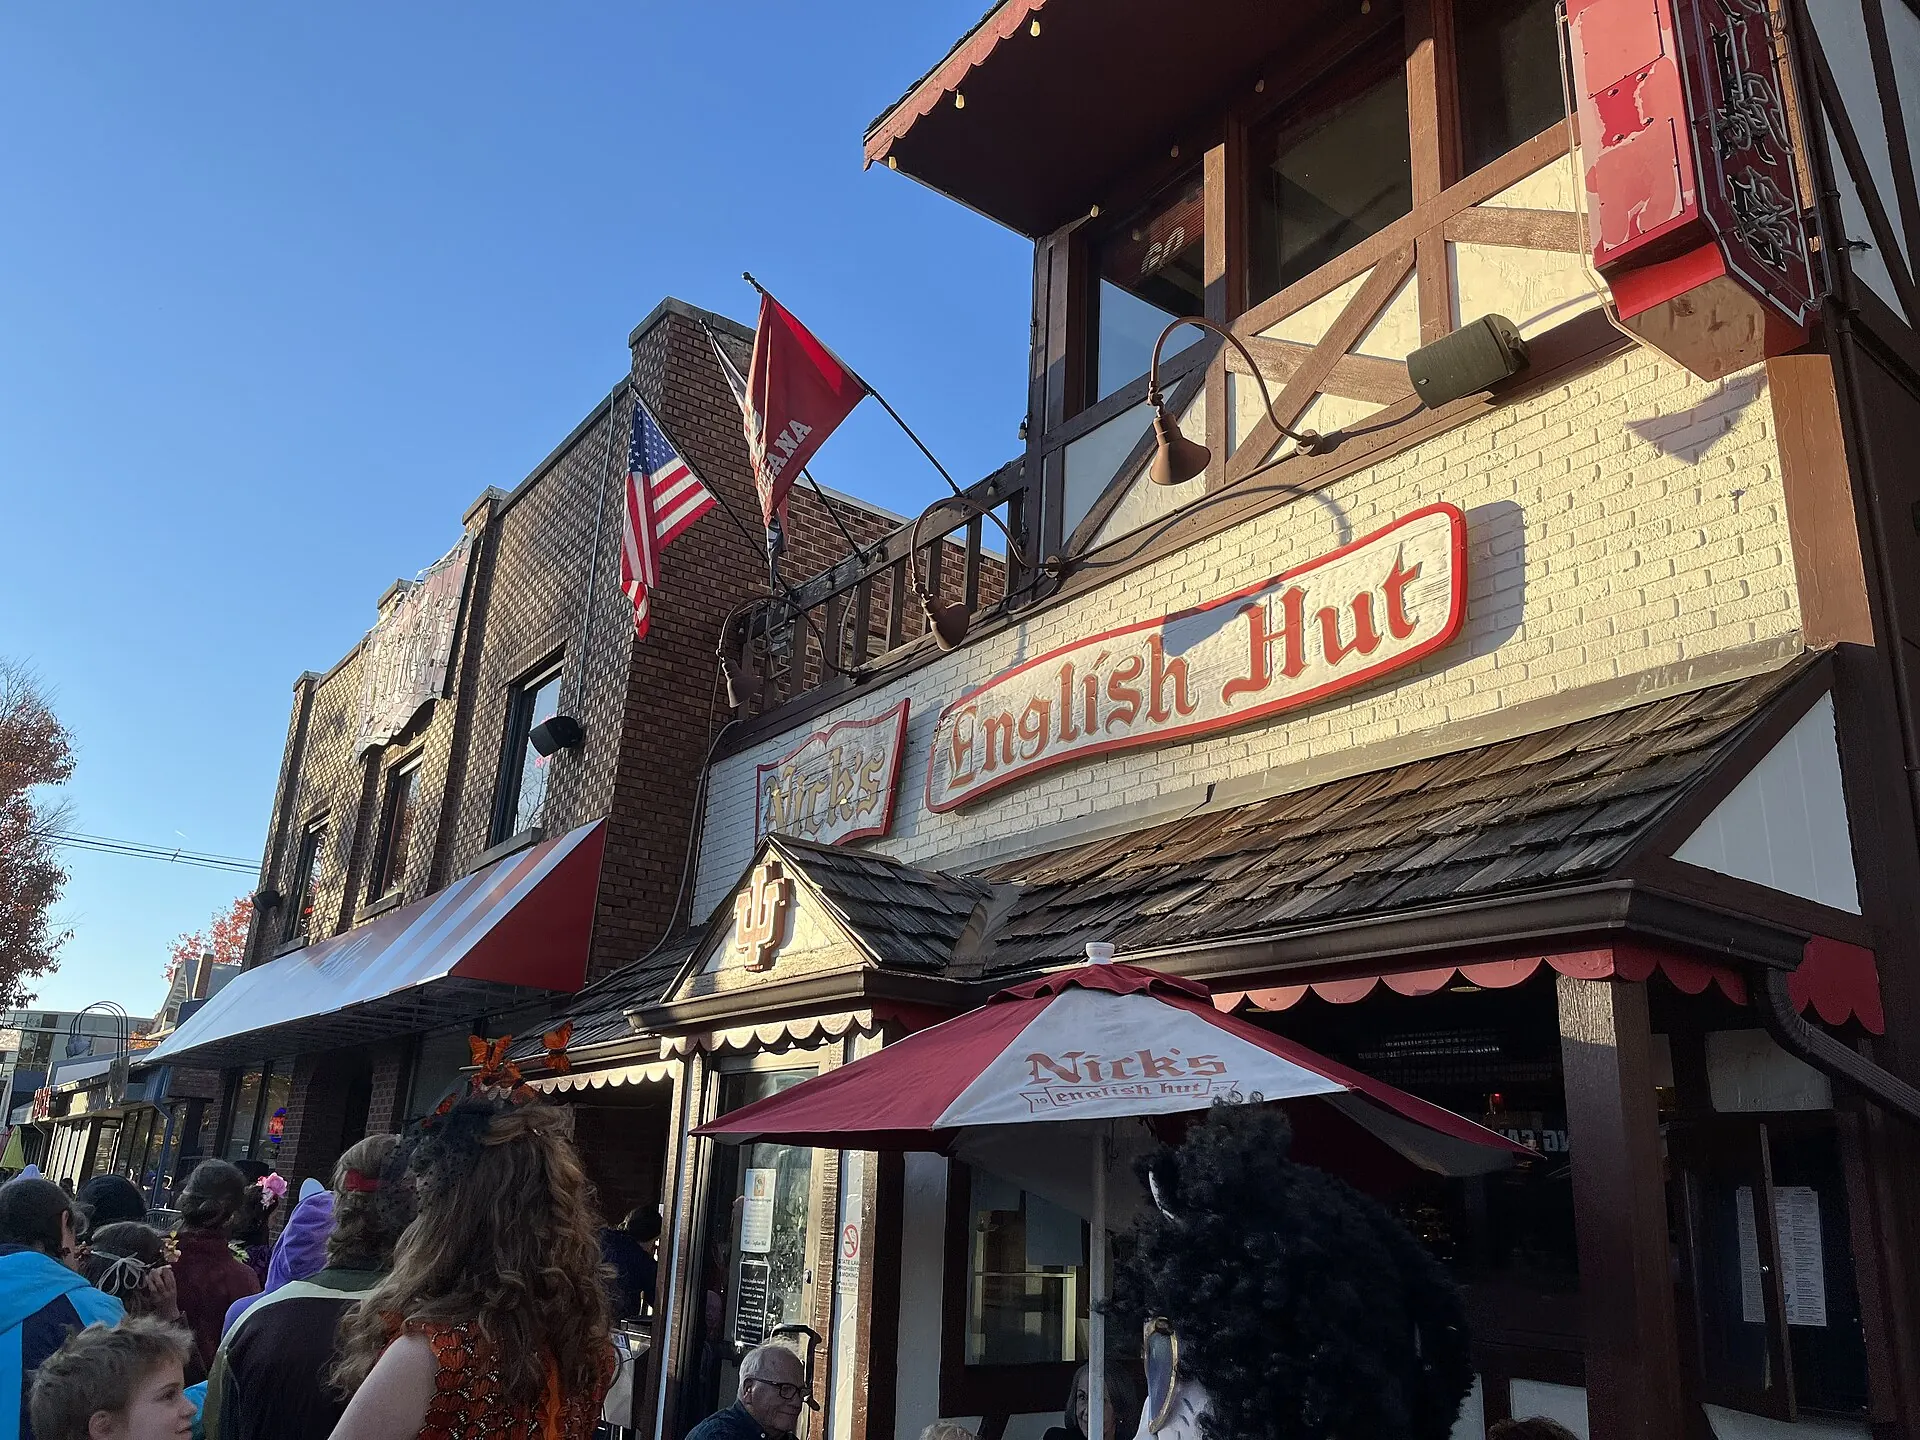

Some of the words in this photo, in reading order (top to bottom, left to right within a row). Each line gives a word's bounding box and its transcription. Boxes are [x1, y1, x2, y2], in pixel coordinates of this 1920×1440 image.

[947, 633, 1199, 790] English
[1222, 543, 1423, 708] Hut
[764, 745, 885, 836] Nick's
[1024, 1048, 1227, 1086] Nick's
[1055, 1084, 1152, 1102] english
[1160, 1082, 1201, 1094] hut
